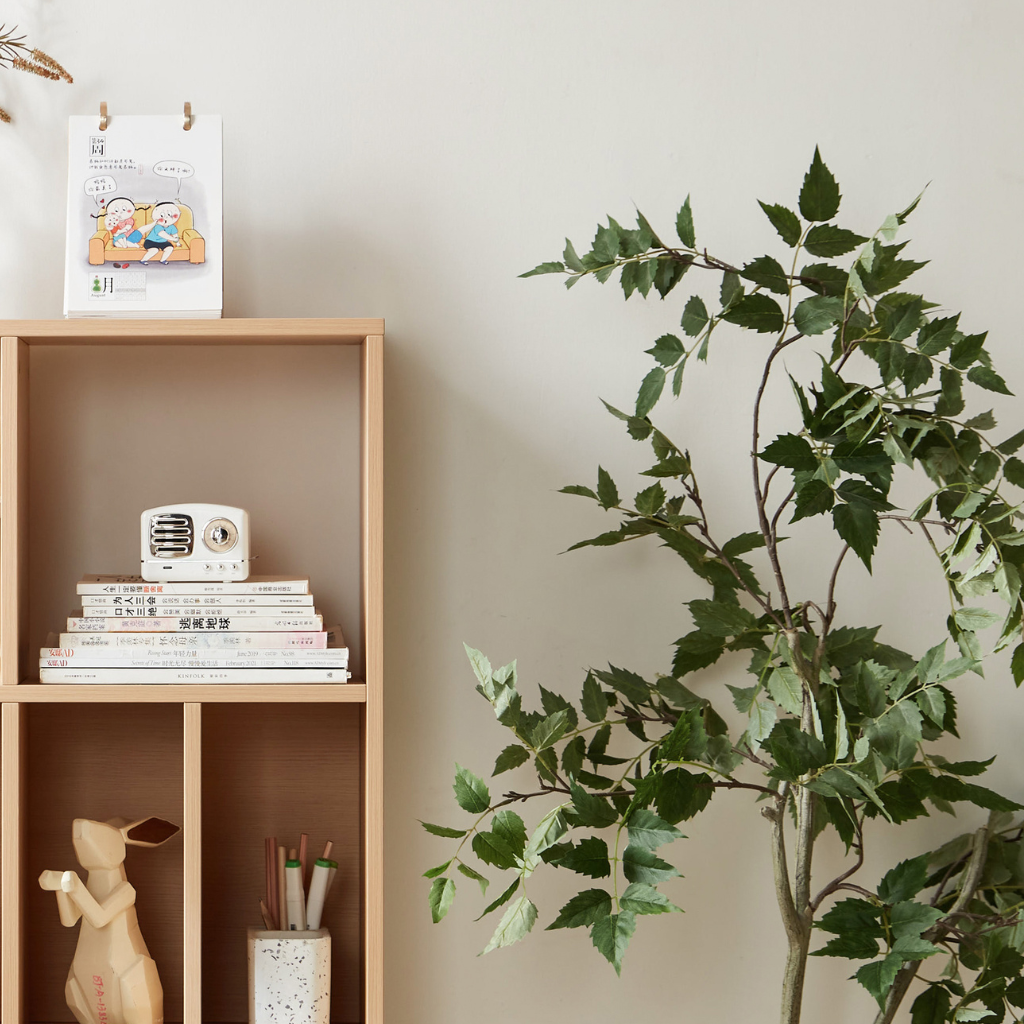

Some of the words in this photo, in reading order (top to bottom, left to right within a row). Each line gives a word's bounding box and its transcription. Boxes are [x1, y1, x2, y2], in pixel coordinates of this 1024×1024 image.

[92, 144, 104, 155] 周
[113, 596, 156, 605] 为人三会
[114, 607, 157, 616] 口才三绝
[179, 617, 231, 630] 逃离地球
[159, 636, 198, 645] 怀念母亲
